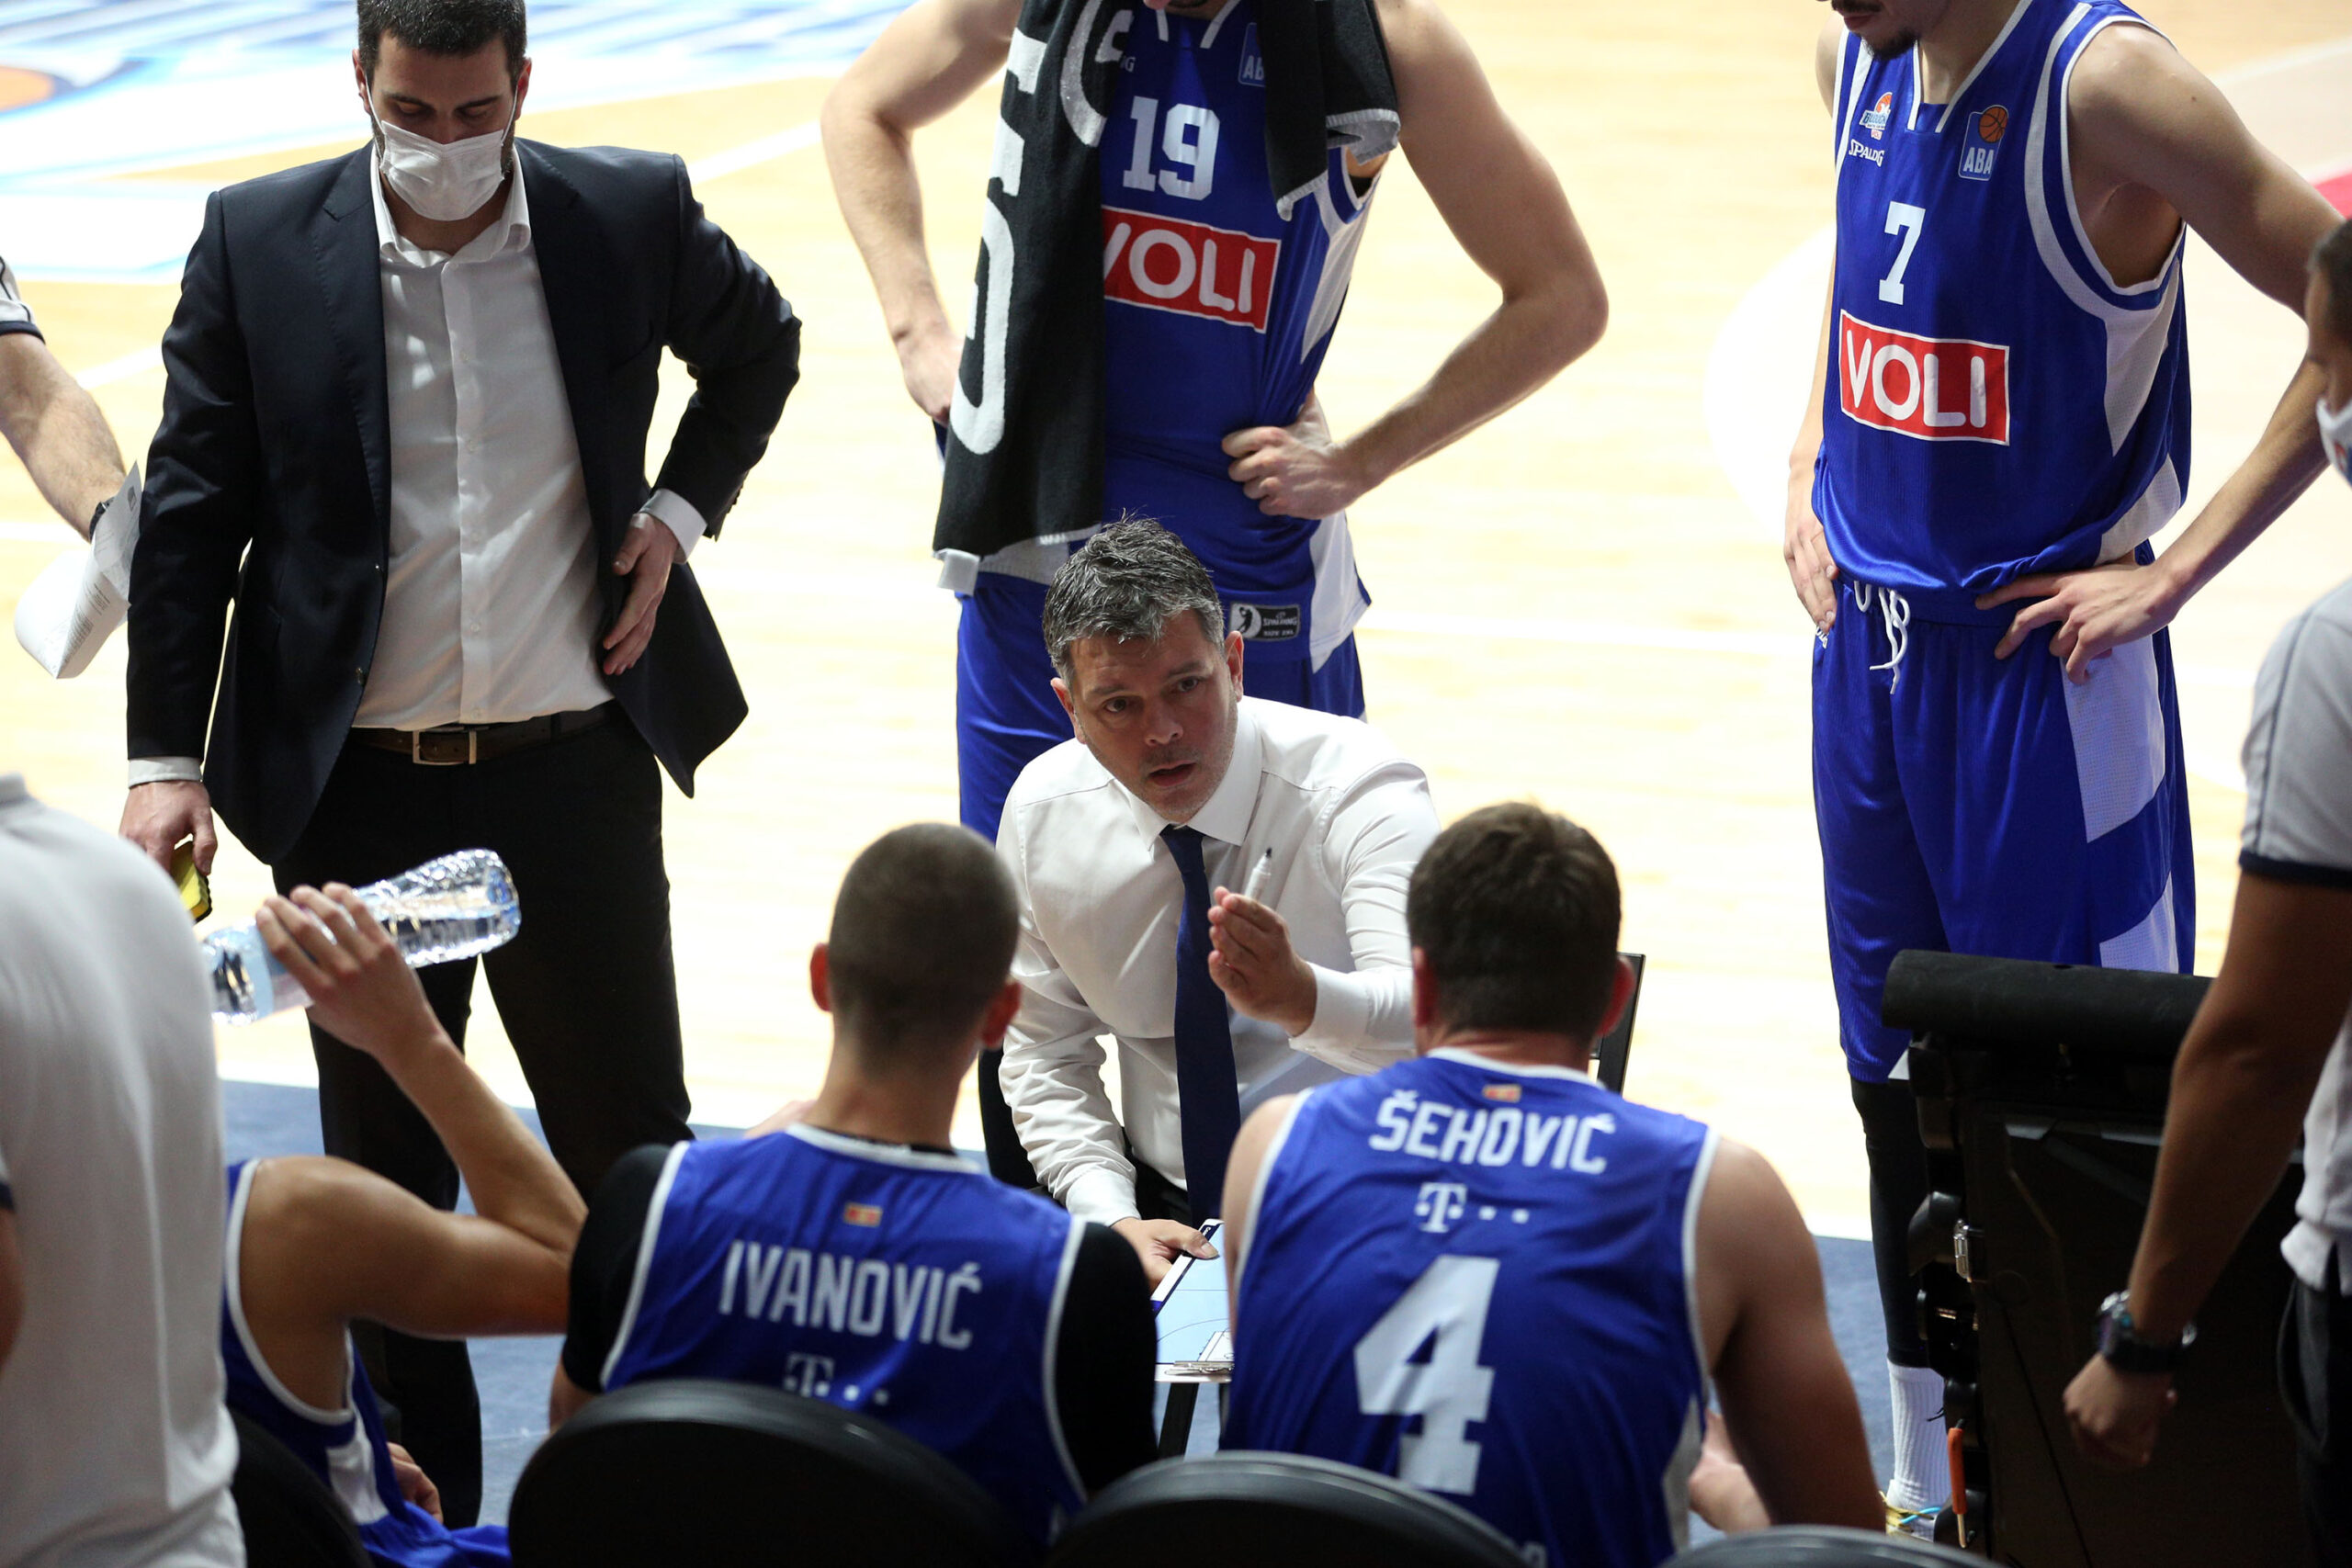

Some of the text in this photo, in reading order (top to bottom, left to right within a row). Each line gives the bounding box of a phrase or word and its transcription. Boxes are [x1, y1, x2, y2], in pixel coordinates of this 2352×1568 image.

[1123, 96, 1220, 200] 19
[1963, 148, 1995, 175] ABA
[1879, 200, 1926, 305] 7
[1847, 331, 1986, 428] VOLI
[1369, 1090, 1615, 1174] ŠEHOVIĆ
[718, 1239, 981, 1350] IVANOVIĆ
[1353, 1255, 1500, 1495] 4
